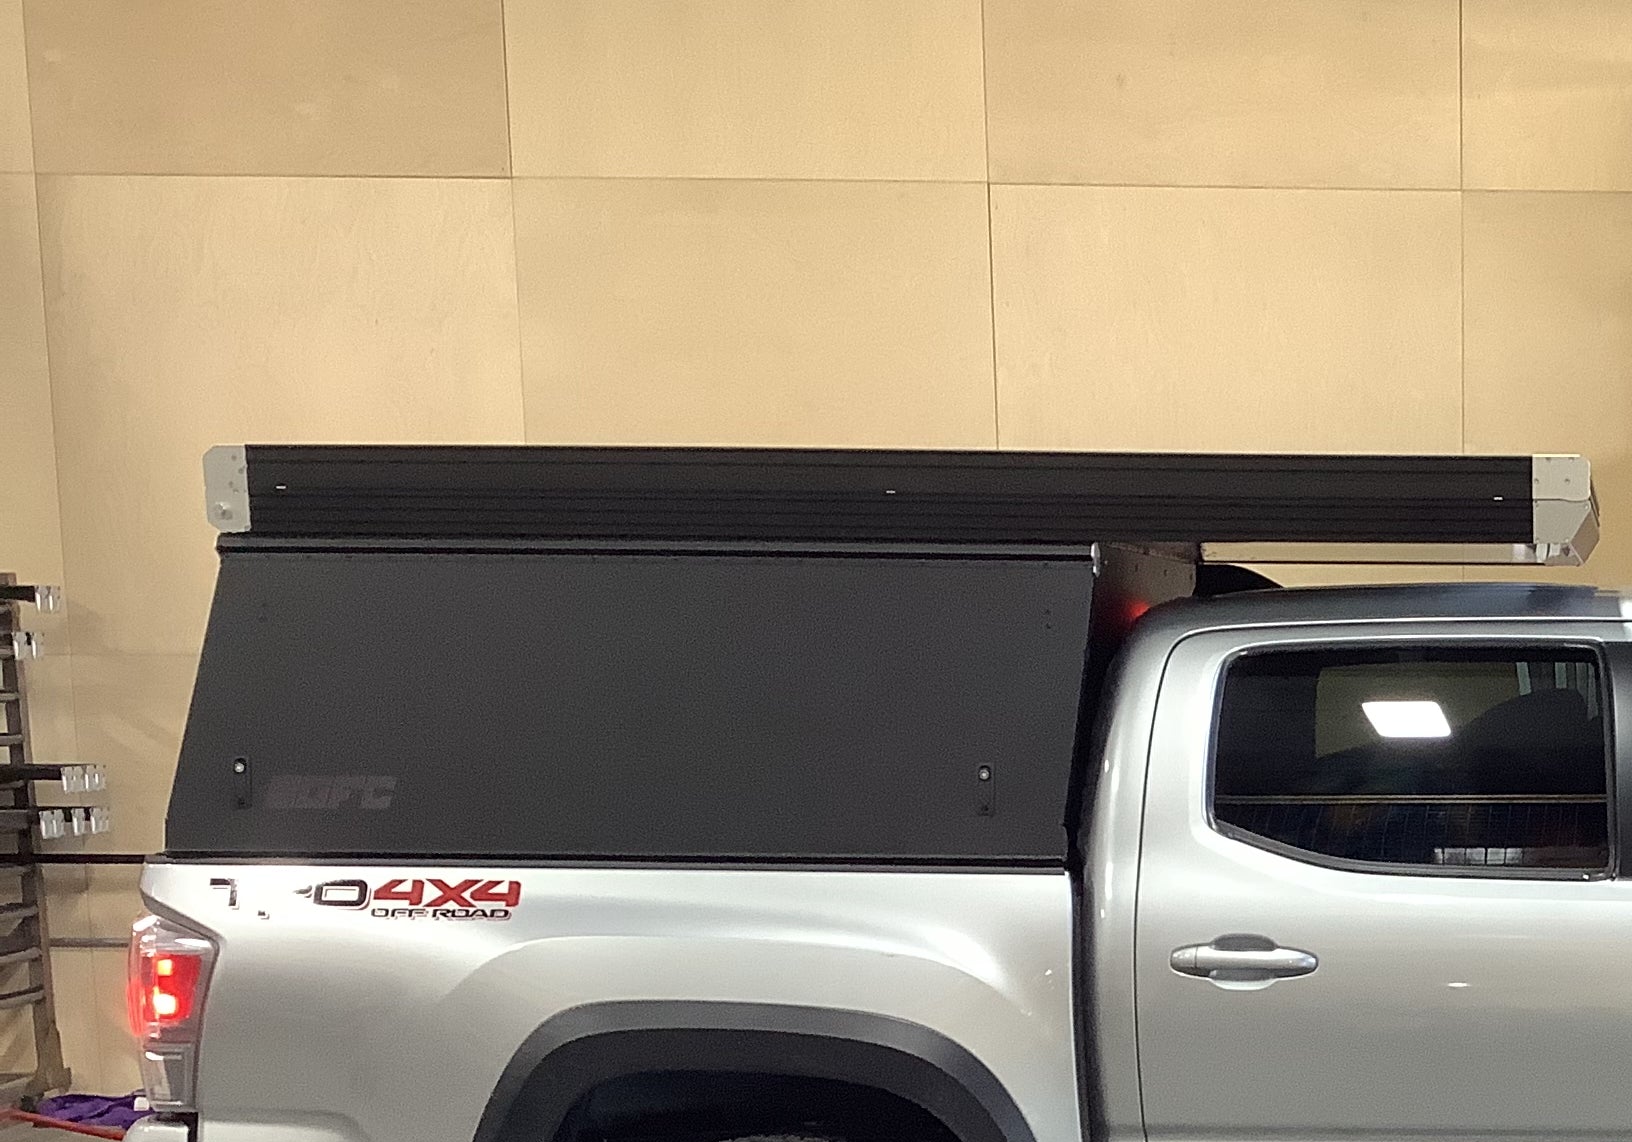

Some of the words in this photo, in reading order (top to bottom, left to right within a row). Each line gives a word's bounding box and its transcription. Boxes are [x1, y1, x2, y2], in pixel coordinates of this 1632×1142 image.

[373, 878, 522, 908] 4X4
[371, 908, 428, 919] OFF
[432, 908, 512, 920] ROAD
